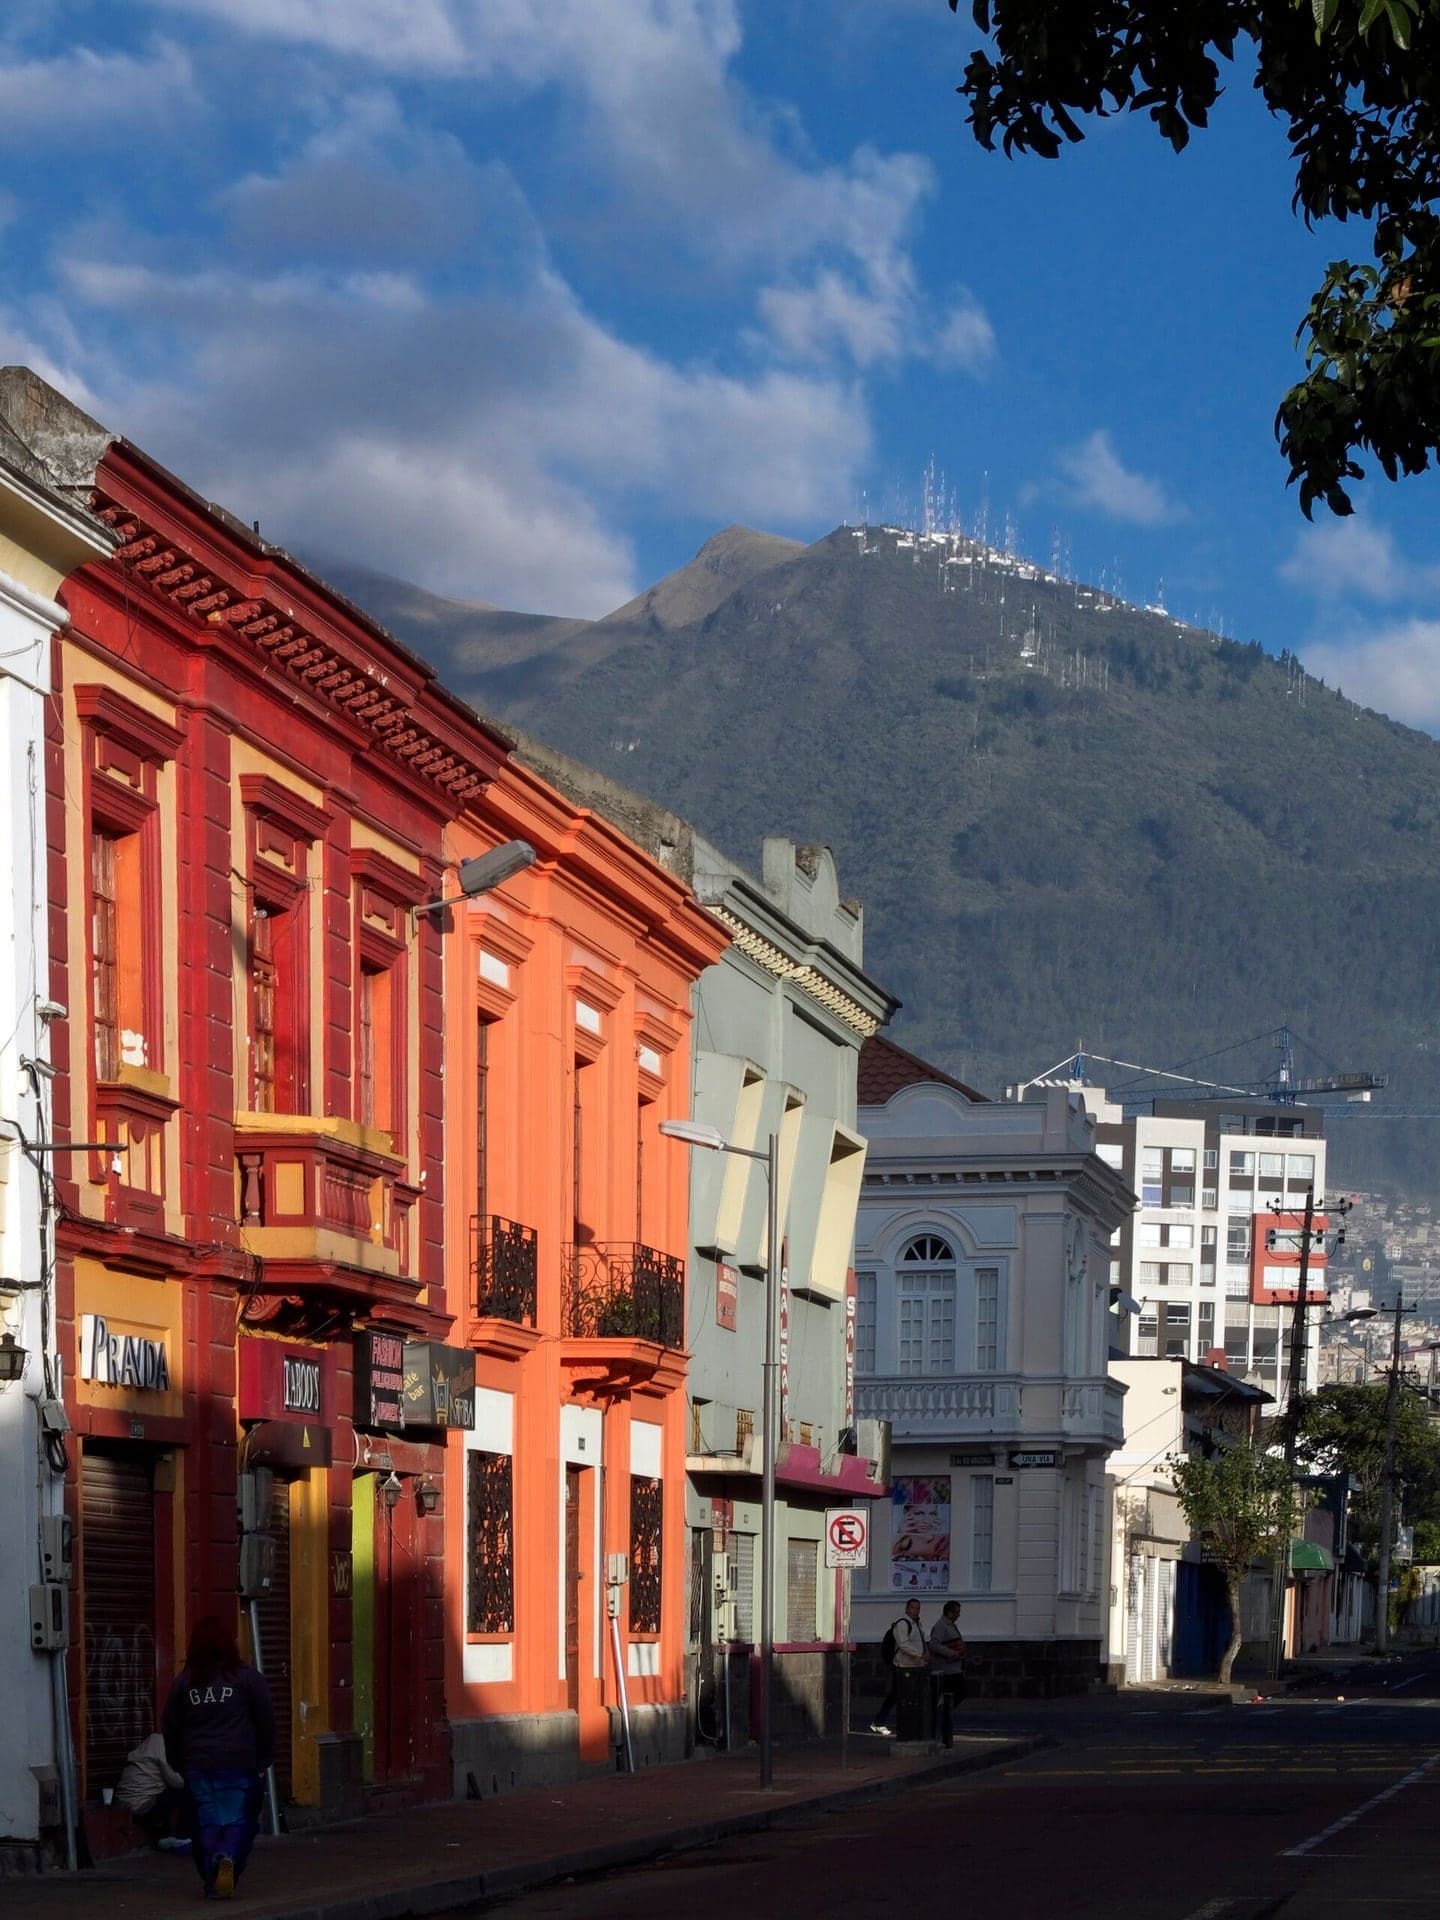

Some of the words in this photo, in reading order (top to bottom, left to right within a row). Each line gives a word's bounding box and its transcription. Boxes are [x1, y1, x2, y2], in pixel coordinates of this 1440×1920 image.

[81, 1314, 170, 1391] PRAVDA
[372, 1335, 402, 1369] FASHION
[284, 1360, 320, 1410] TABOO'S
[403, 1370, 419, 1391] afé
[407, 1384, 425, 1402] bar
[1022, 1455, 1036, 1464] UNA
[838, 1521, 858, 1545] E
[189, 1686, 233, 1705] GAP
